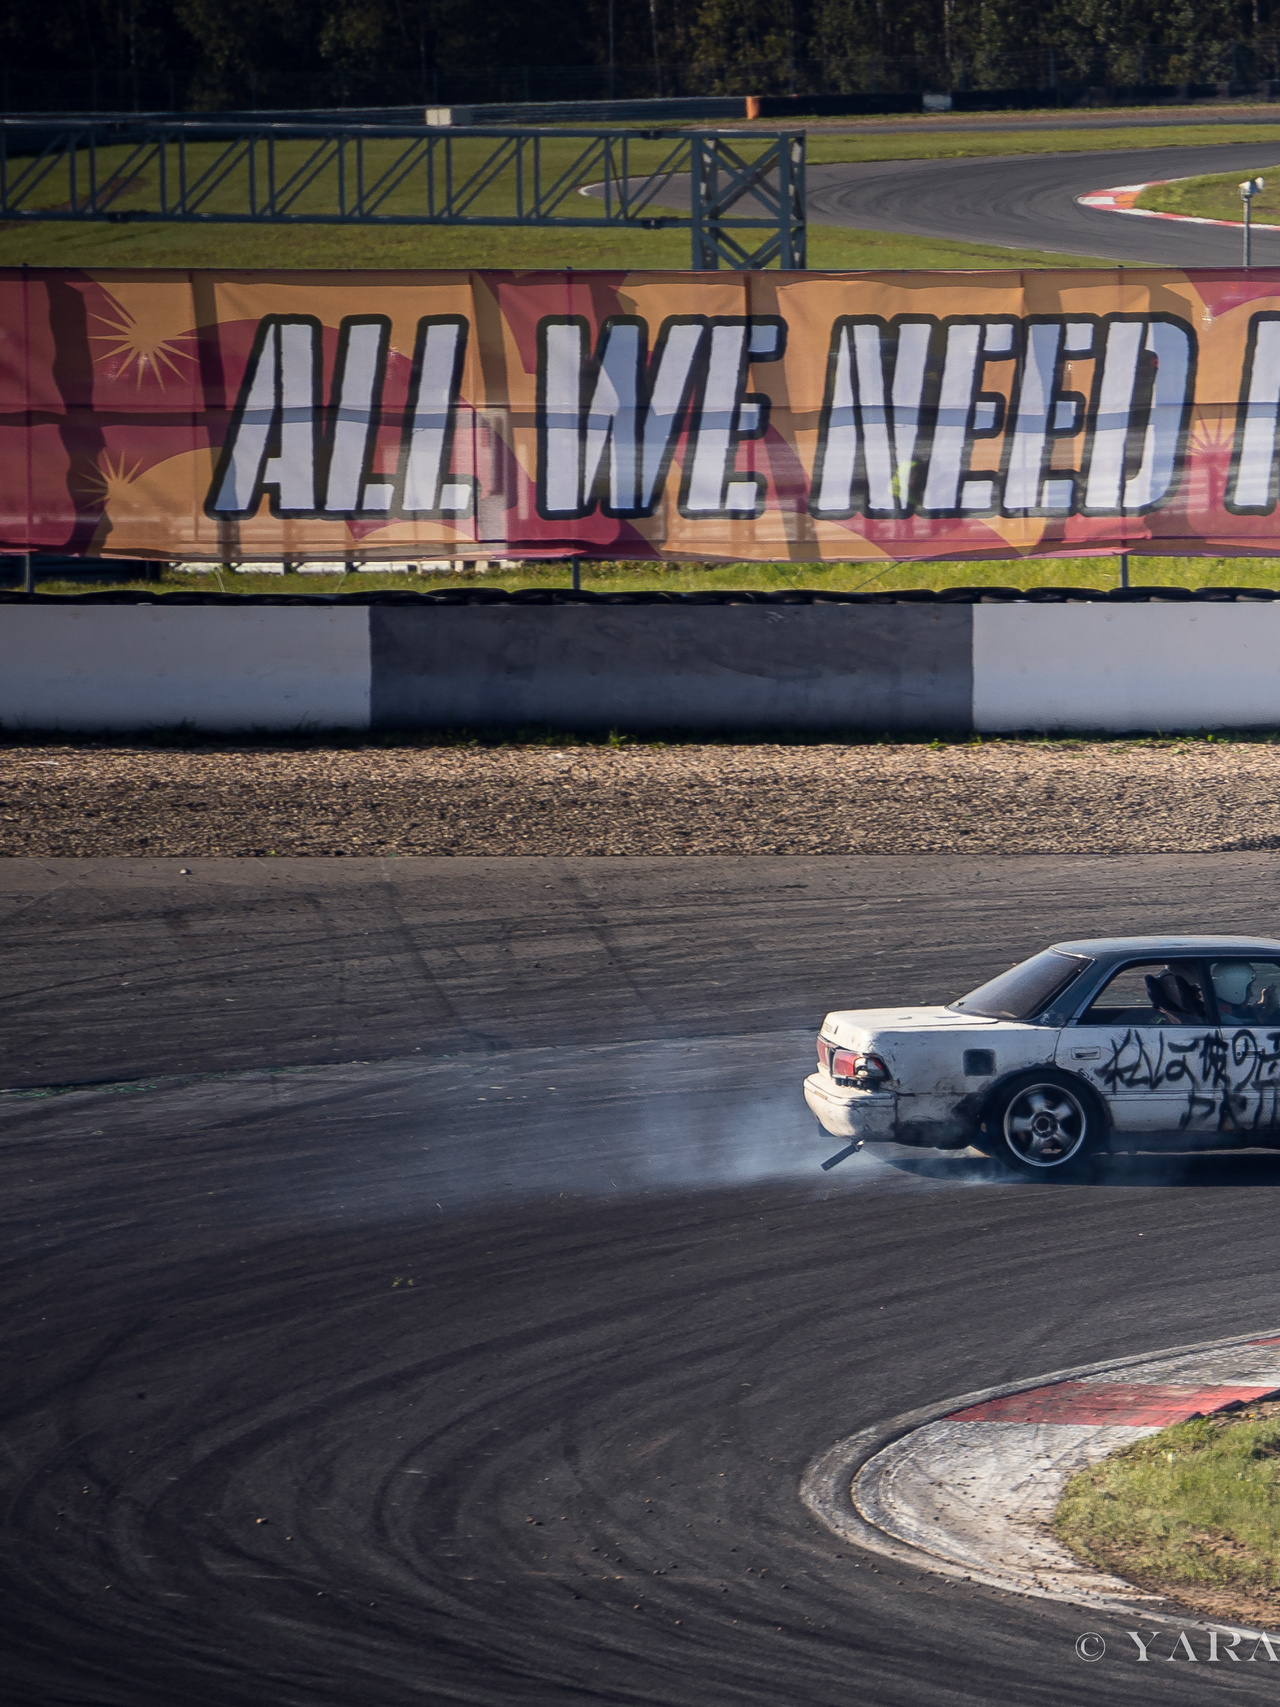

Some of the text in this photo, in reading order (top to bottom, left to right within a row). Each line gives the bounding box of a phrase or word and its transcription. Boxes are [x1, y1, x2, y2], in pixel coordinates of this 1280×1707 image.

[206, 315, 477, 519] ALL
[539, 315, 787, 519] WE
[813, 313, 1196, 519] NEED
